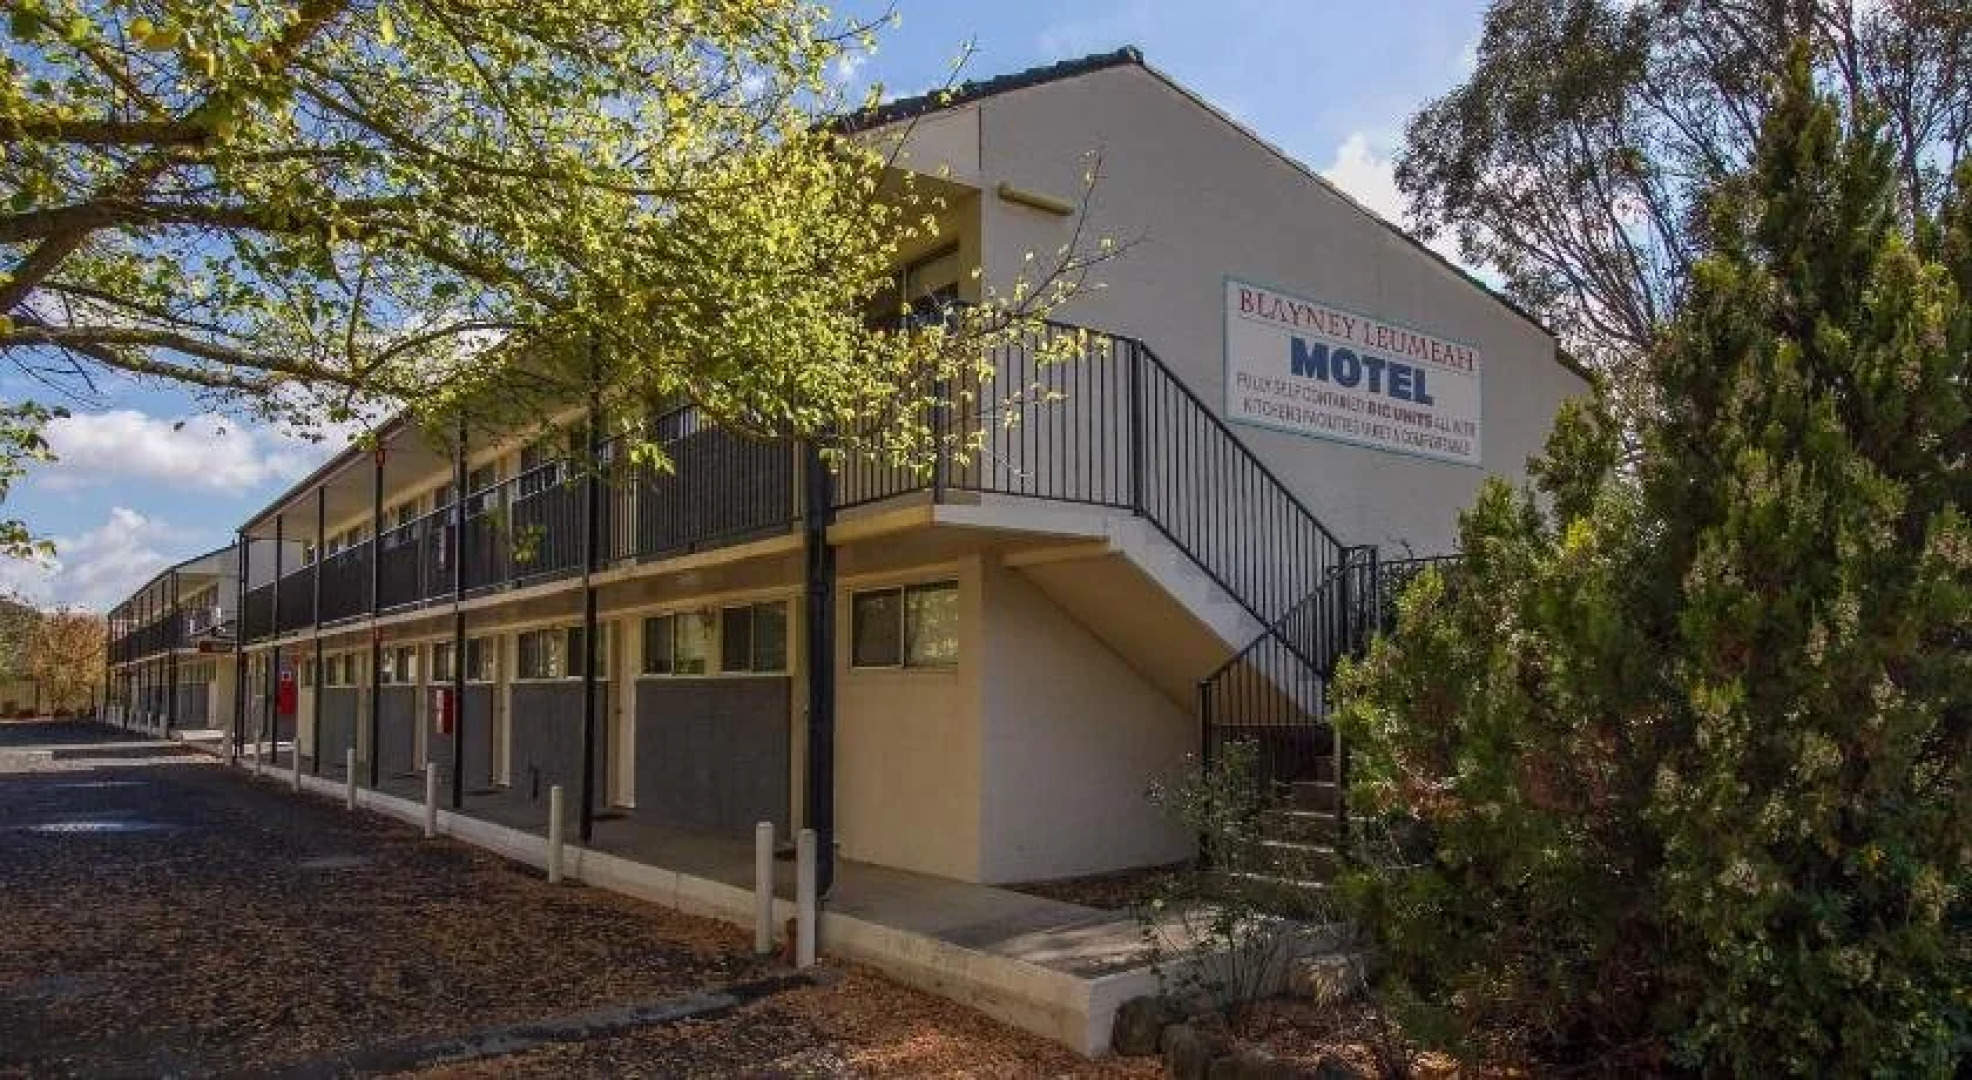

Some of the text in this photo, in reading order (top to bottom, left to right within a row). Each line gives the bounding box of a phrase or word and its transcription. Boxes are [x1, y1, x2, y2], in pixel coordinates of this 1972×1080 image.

[1239, 287, 1473, 371] BLAYNEY LEUMEAH
[1290, 336, 1434, 406] MOTEL
